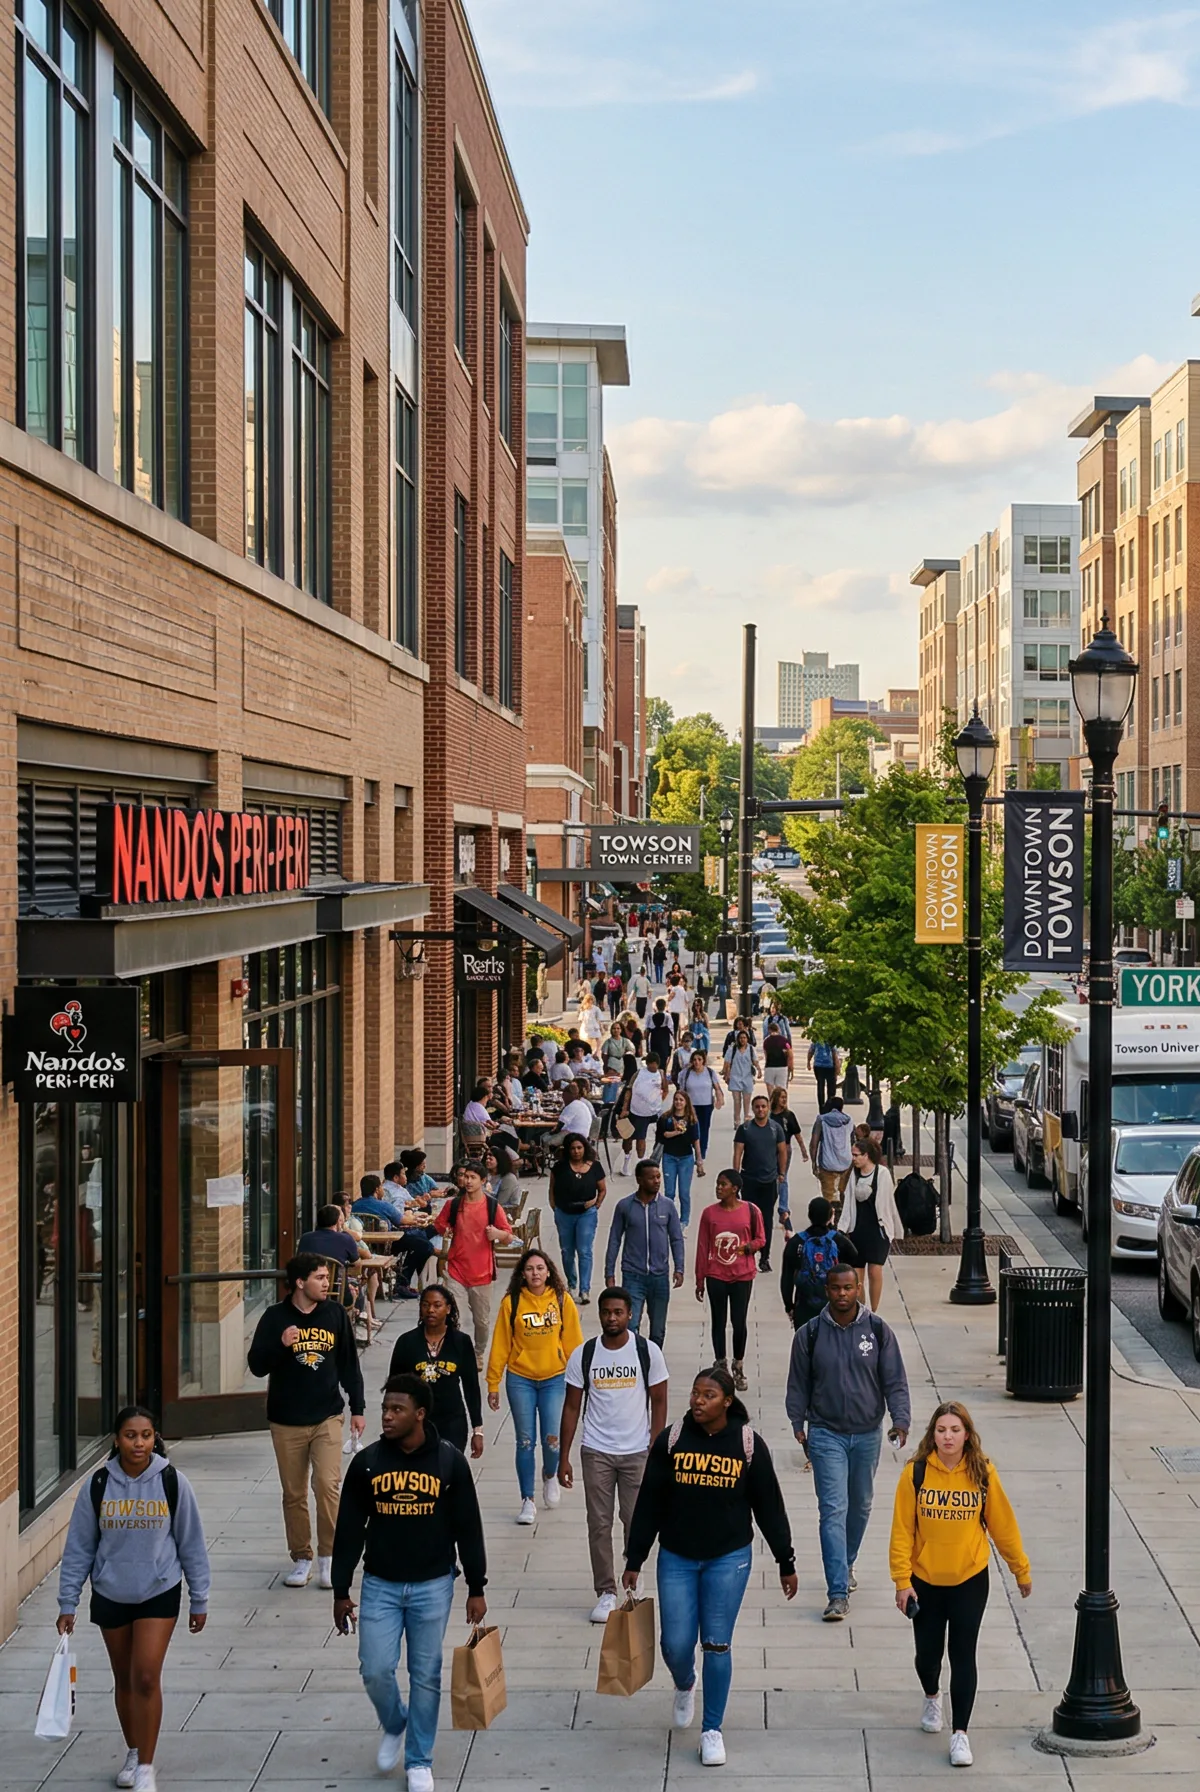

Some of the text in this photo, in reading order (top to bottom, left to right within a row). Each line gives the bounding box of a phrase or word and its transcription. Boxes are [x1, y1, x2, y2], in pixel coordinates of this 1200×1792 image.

[114, 803, 310, 904] NANDO'S PERI-PERI
[599, 835, 692, 852] TOWSON
[600, 854, 693, 865] TOWN CENTER
[925, 833, 938, 929] DOWNTOWN
[941, 835, 959, 931] TOWSON
[1024, 807, 1042, 957] DOWNTOWN
[1047, 807, 1074, 959] TOWSON
[24, 1051, 126, 1071] Nando's
[1115, 1043, 1158, 1054] Towson
[592, 1366, 637, 1380] TOWSON
[673, 1452, 743, 1478] TOWSON
[371, 1471, 441, 1498] TOWSON
[375, 1501, 435, 1516] UNIVERSITY
